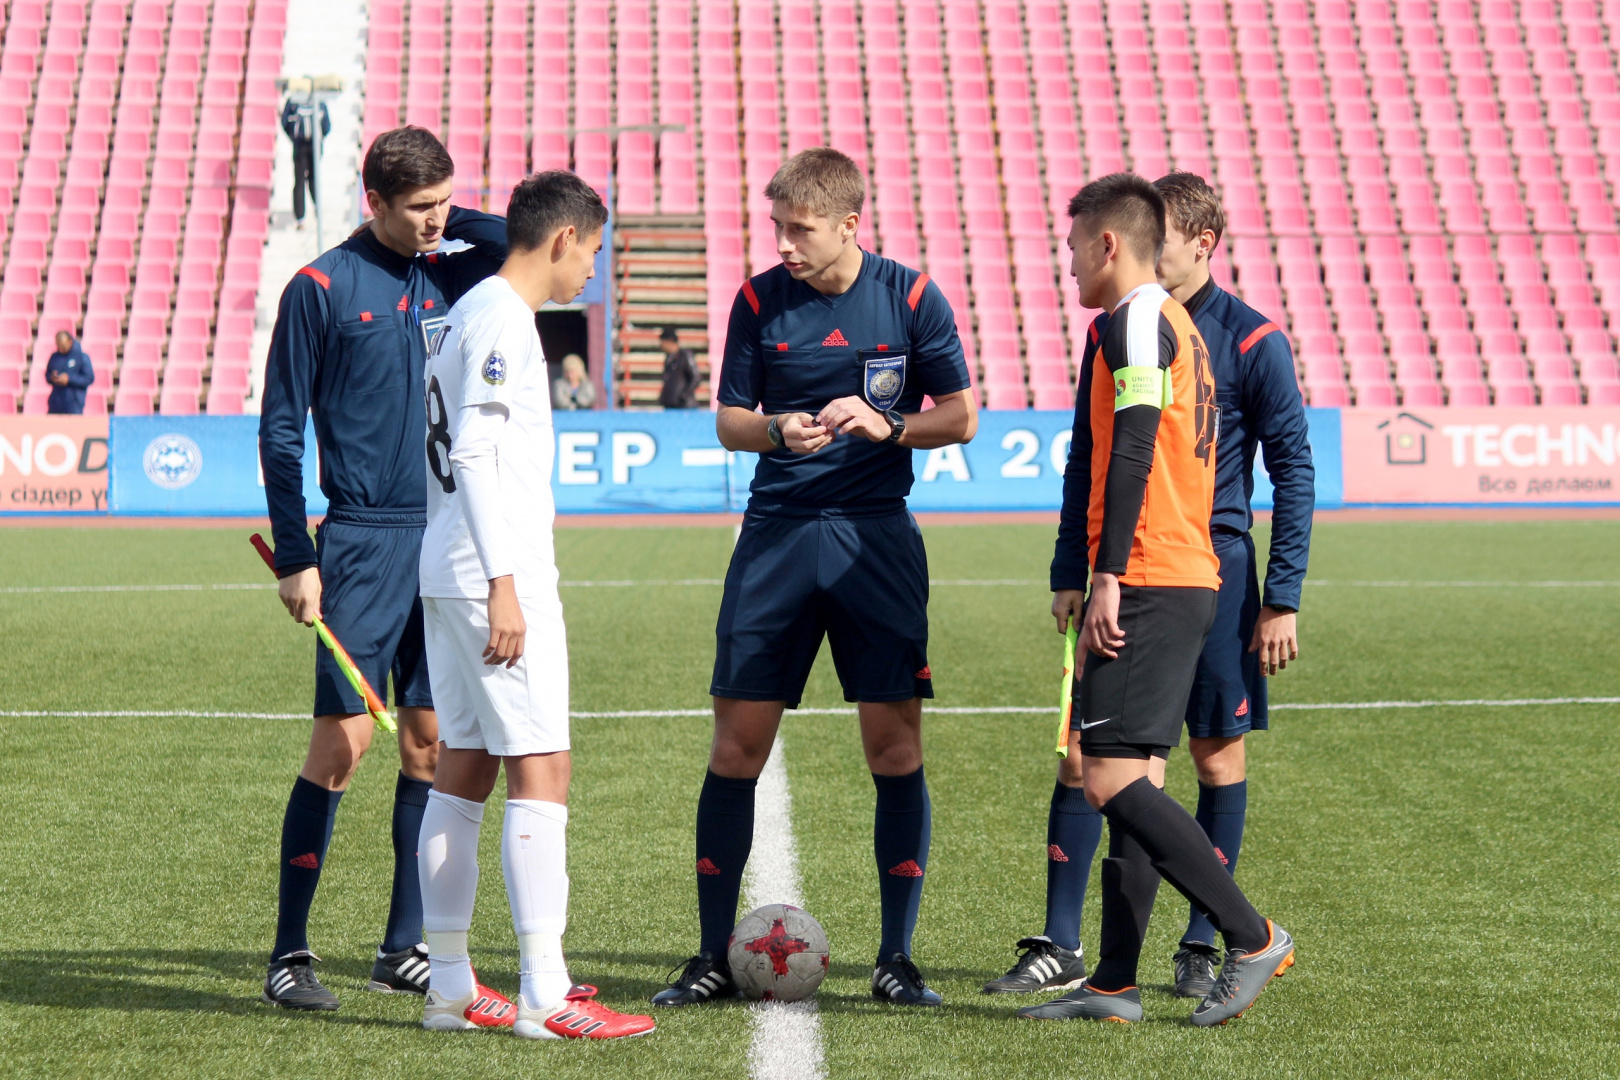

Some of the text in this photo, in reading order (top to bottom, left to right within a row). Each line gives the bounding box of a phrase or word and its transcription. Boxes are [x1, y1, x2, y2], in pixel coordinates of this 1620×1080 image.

[1442, 423, 1620, 466] TECHN
[1479, 475, 1613, 494] Все делаем
